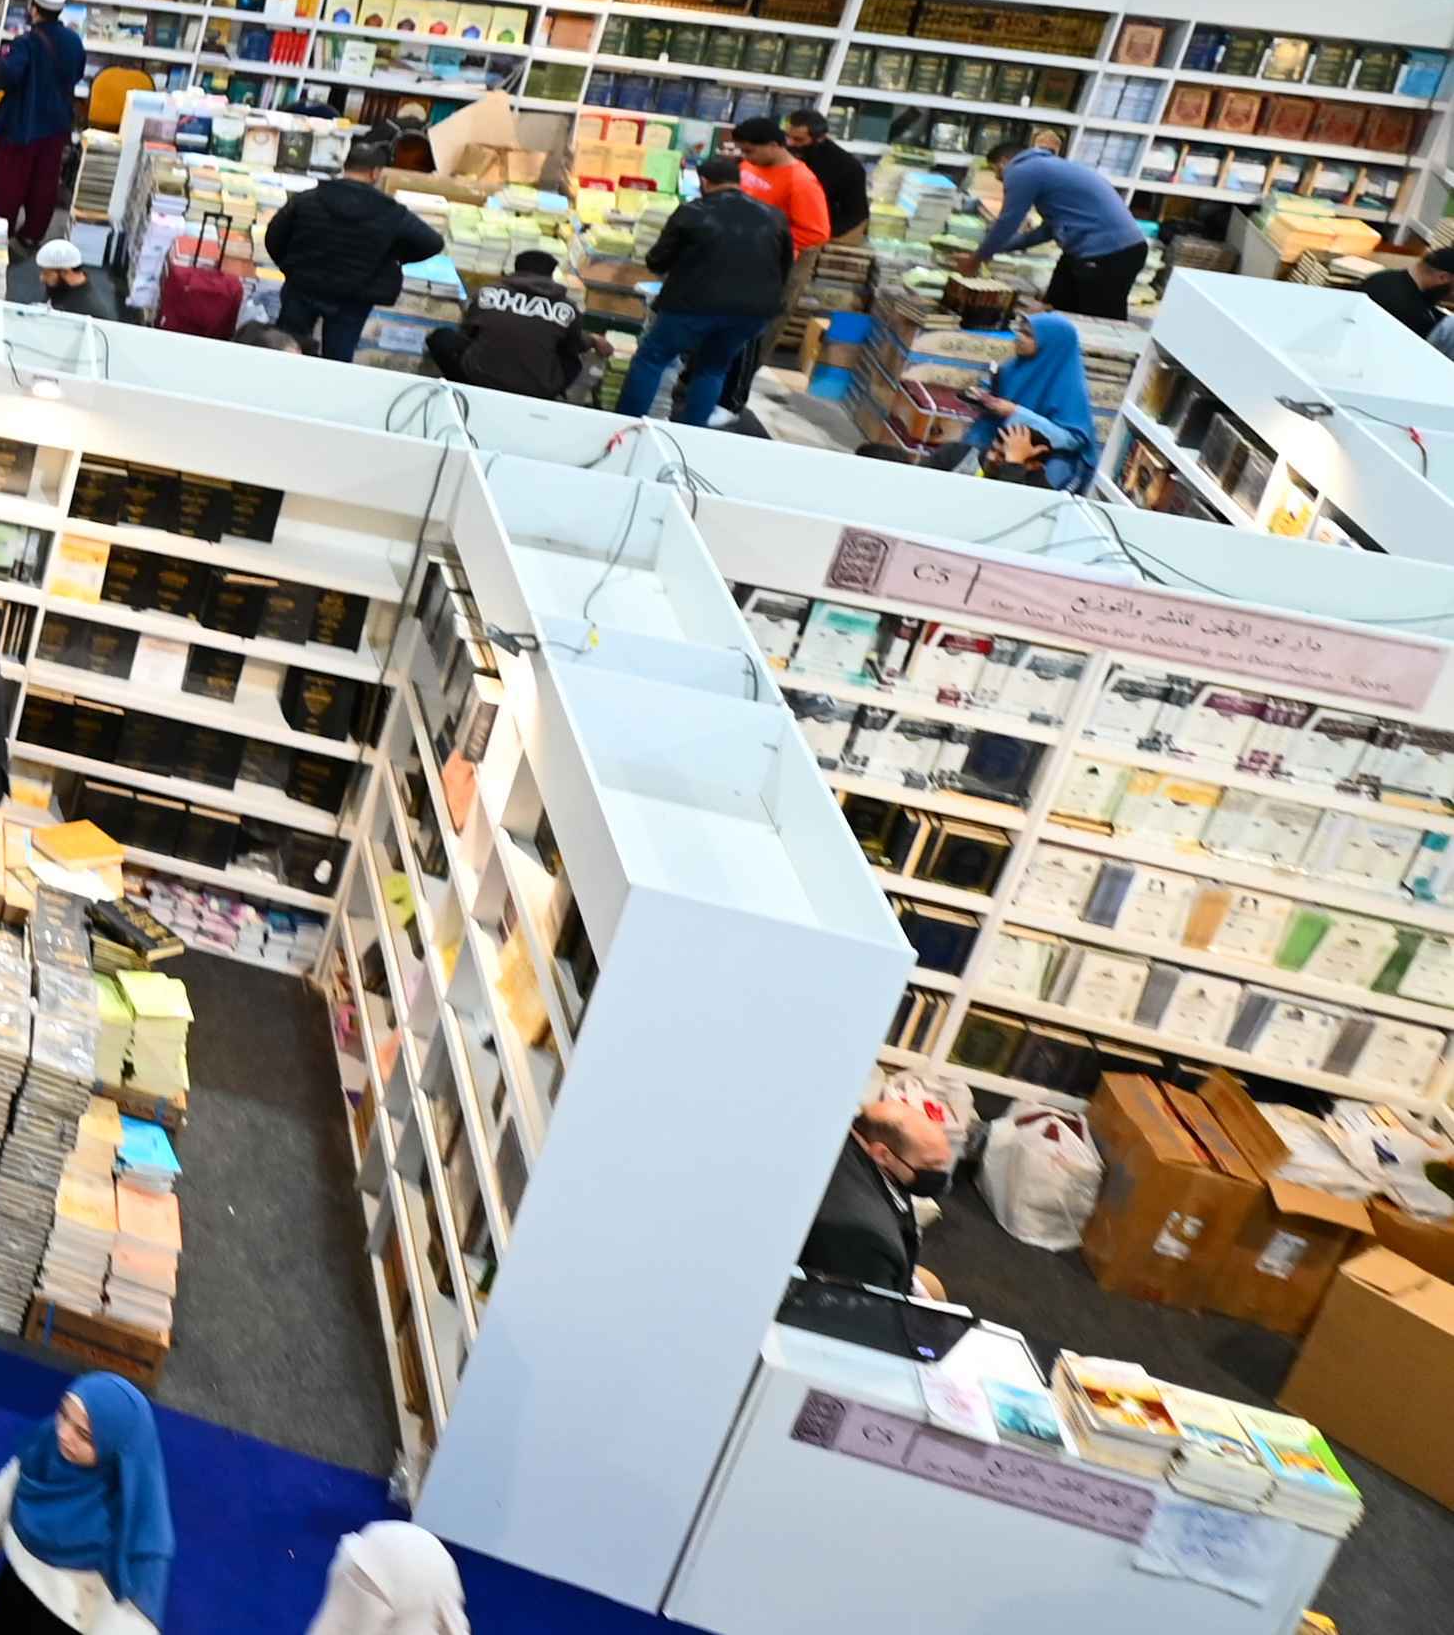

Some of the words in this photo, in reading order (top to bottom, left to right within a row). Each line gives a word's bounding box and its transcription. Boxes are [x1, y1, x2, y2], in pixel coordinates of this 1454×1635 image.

[478, 286, 576, 328] SHAQ
[913, 563, 950, 586] C5
[1070, 592, 1142, 618] والتوزيع
[1290, 635, 1323, 653] دار
